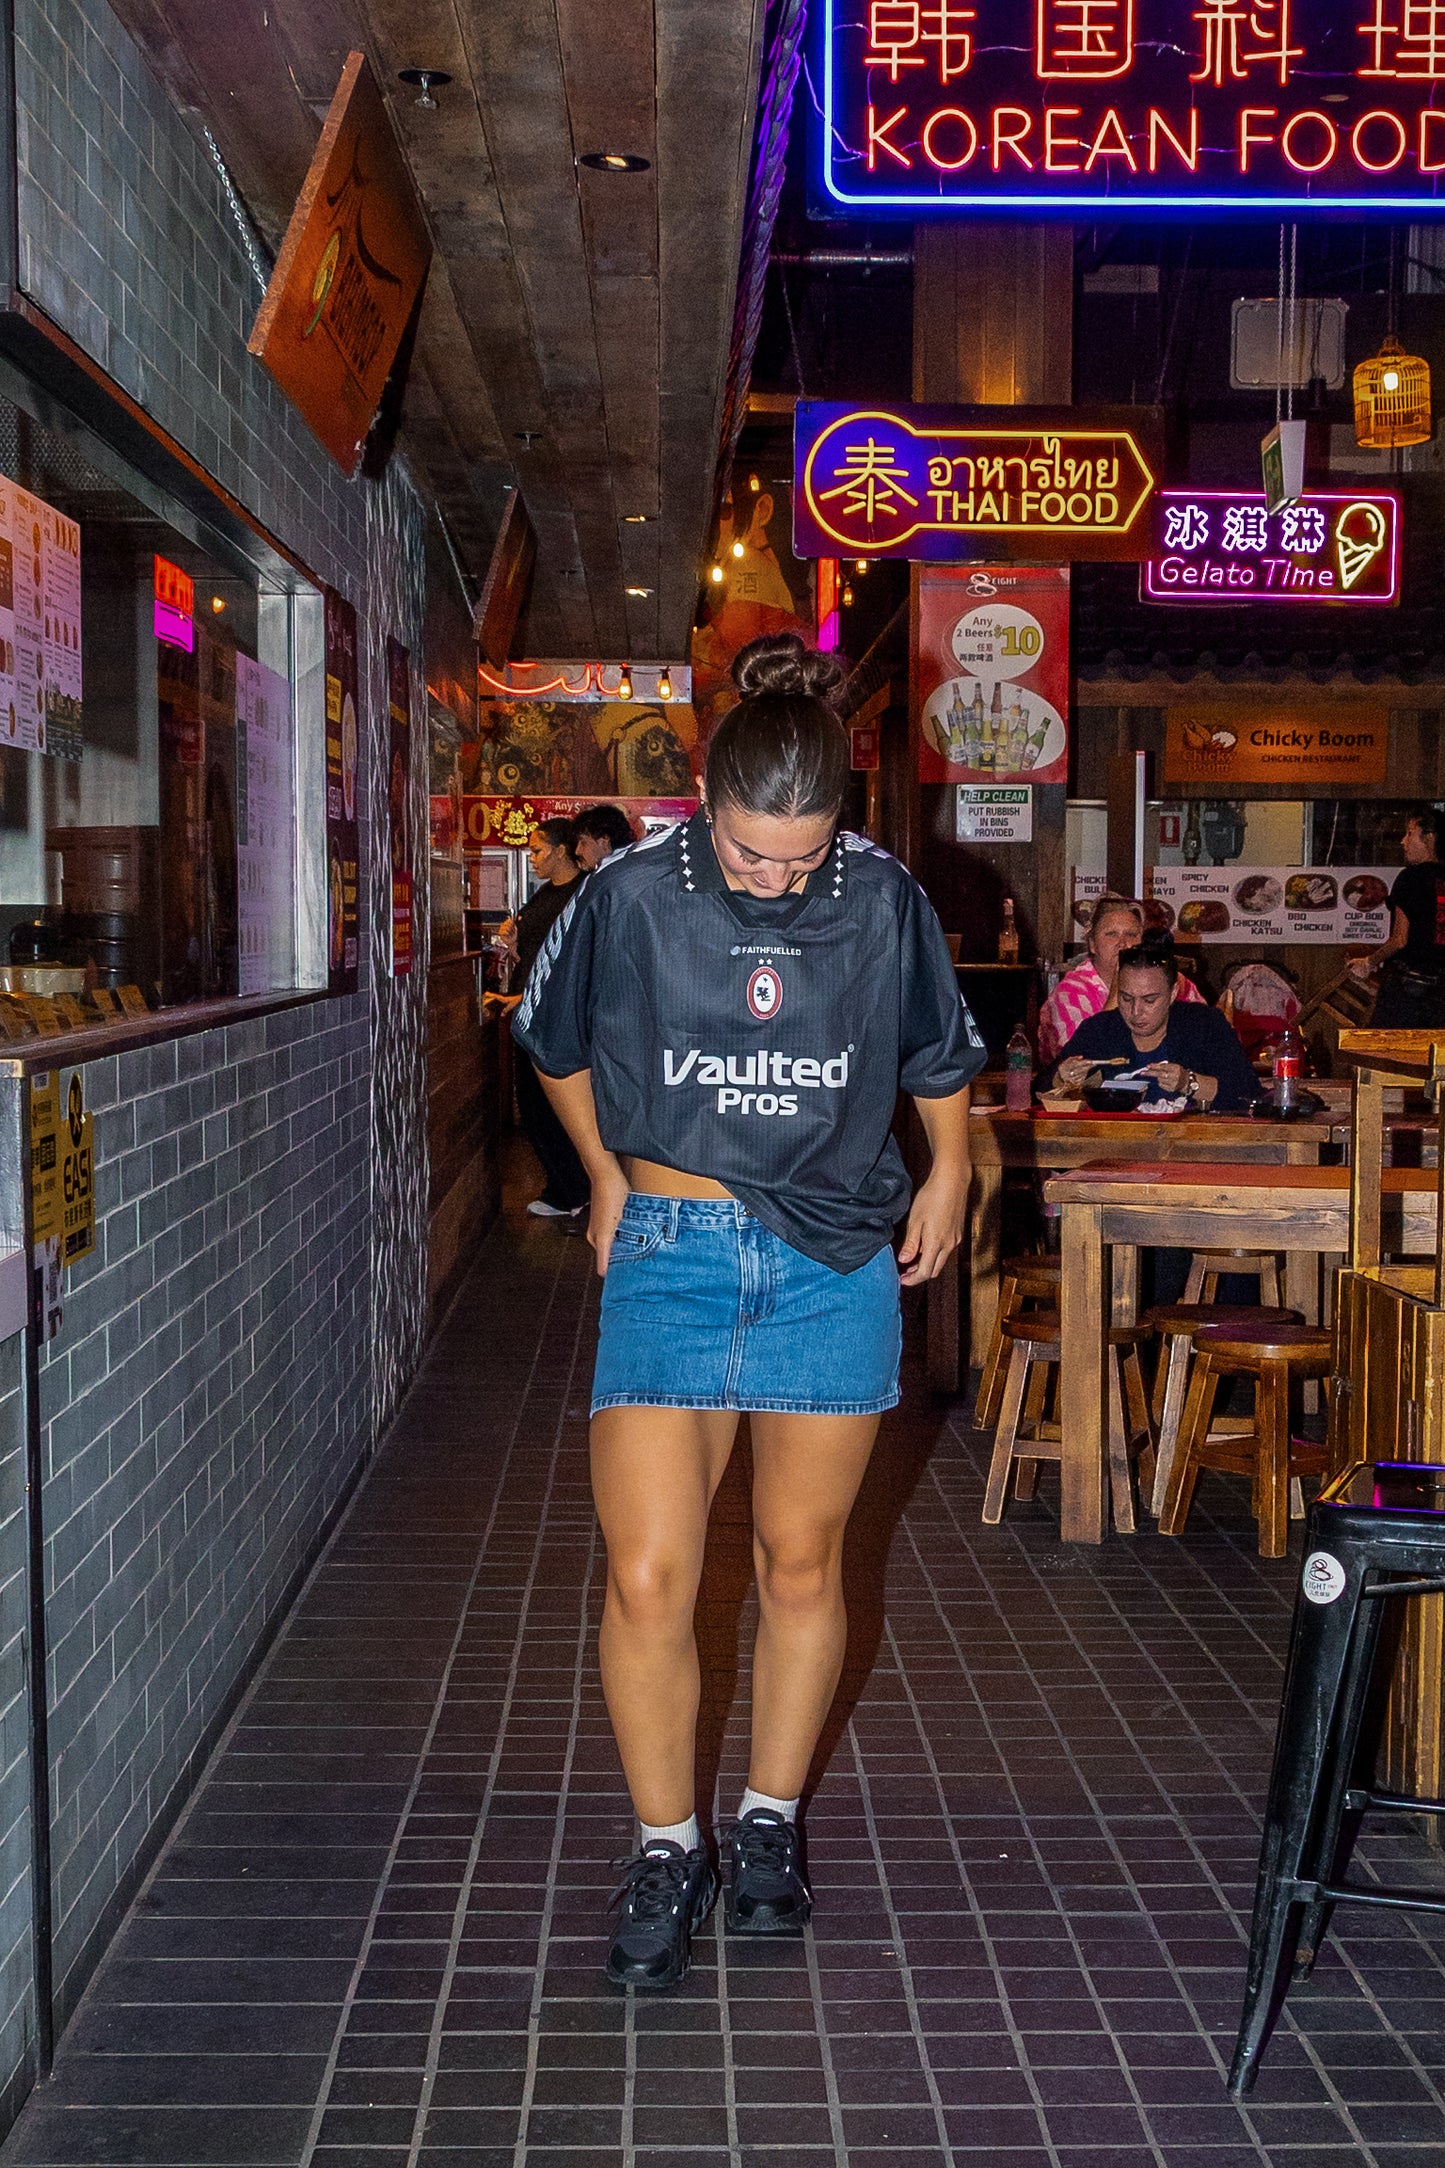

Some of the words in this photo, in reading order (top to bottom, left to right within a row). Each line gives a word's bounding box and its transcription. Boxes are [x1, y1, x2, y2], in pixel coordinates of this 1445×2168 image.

[867, 107, 1196, 172] KOREAN
[927, 434, 1120, 491] อาหารไทย
[819, 437, 919, 523] 泰
[926, 490, 1009, 522] THAI
[1021, 491, 1119, 523] FOOD
[1164, 505, 1326, 552] 冰淇淋
[1160, 556, 1255, 587] Gelato
[991, 577, 1018, 586] EIGHT
[972, 616, 994, 628] Any
[956, 628, 963, 638] 2
[964, 628, 994, 638] Beers
[994, 624, 1041, 657] $10
[1250, 729, 1313, 751] Chicky
[1318, 729, 1375, 747] Boom
[1260, 754, 1300, 763] CHICKEN
[1302, 754, 1361, 763] RESTAURANT
[963, 791, 989, 801] HELP
[992, 791, 1026, 801] CLEAN
[968, 807, 984, 816] PUT
[985, 807, 1020, 816] RUBBISH
[979, 818, 989, 827] IN
[990, 818, 1009, 827] BINS
[974, 828, 1014, 838] PROVIDED
[1075, 876, 1107, 884] CHICKE
[1181, 873, 1209, 882] SPICY
[1189, 885, 1230, 893] CHICKEN
[1287, 913, 1307, 921] BBQ
[1344, 912, 1363, 921] CUP
[1232, 919, 1272, 927] CHICKEN
[1294, 923, 1333, 931] CHICKEN
[1251, 927, 1283, 935] KATSU
[741, 946, 802, 956] FAITHFUELLED
[664, 1049, 849, 1088] Vaulted
[717, 1088, 799, 1116] Pros
[63, 1146, 93, 1204] EASI
